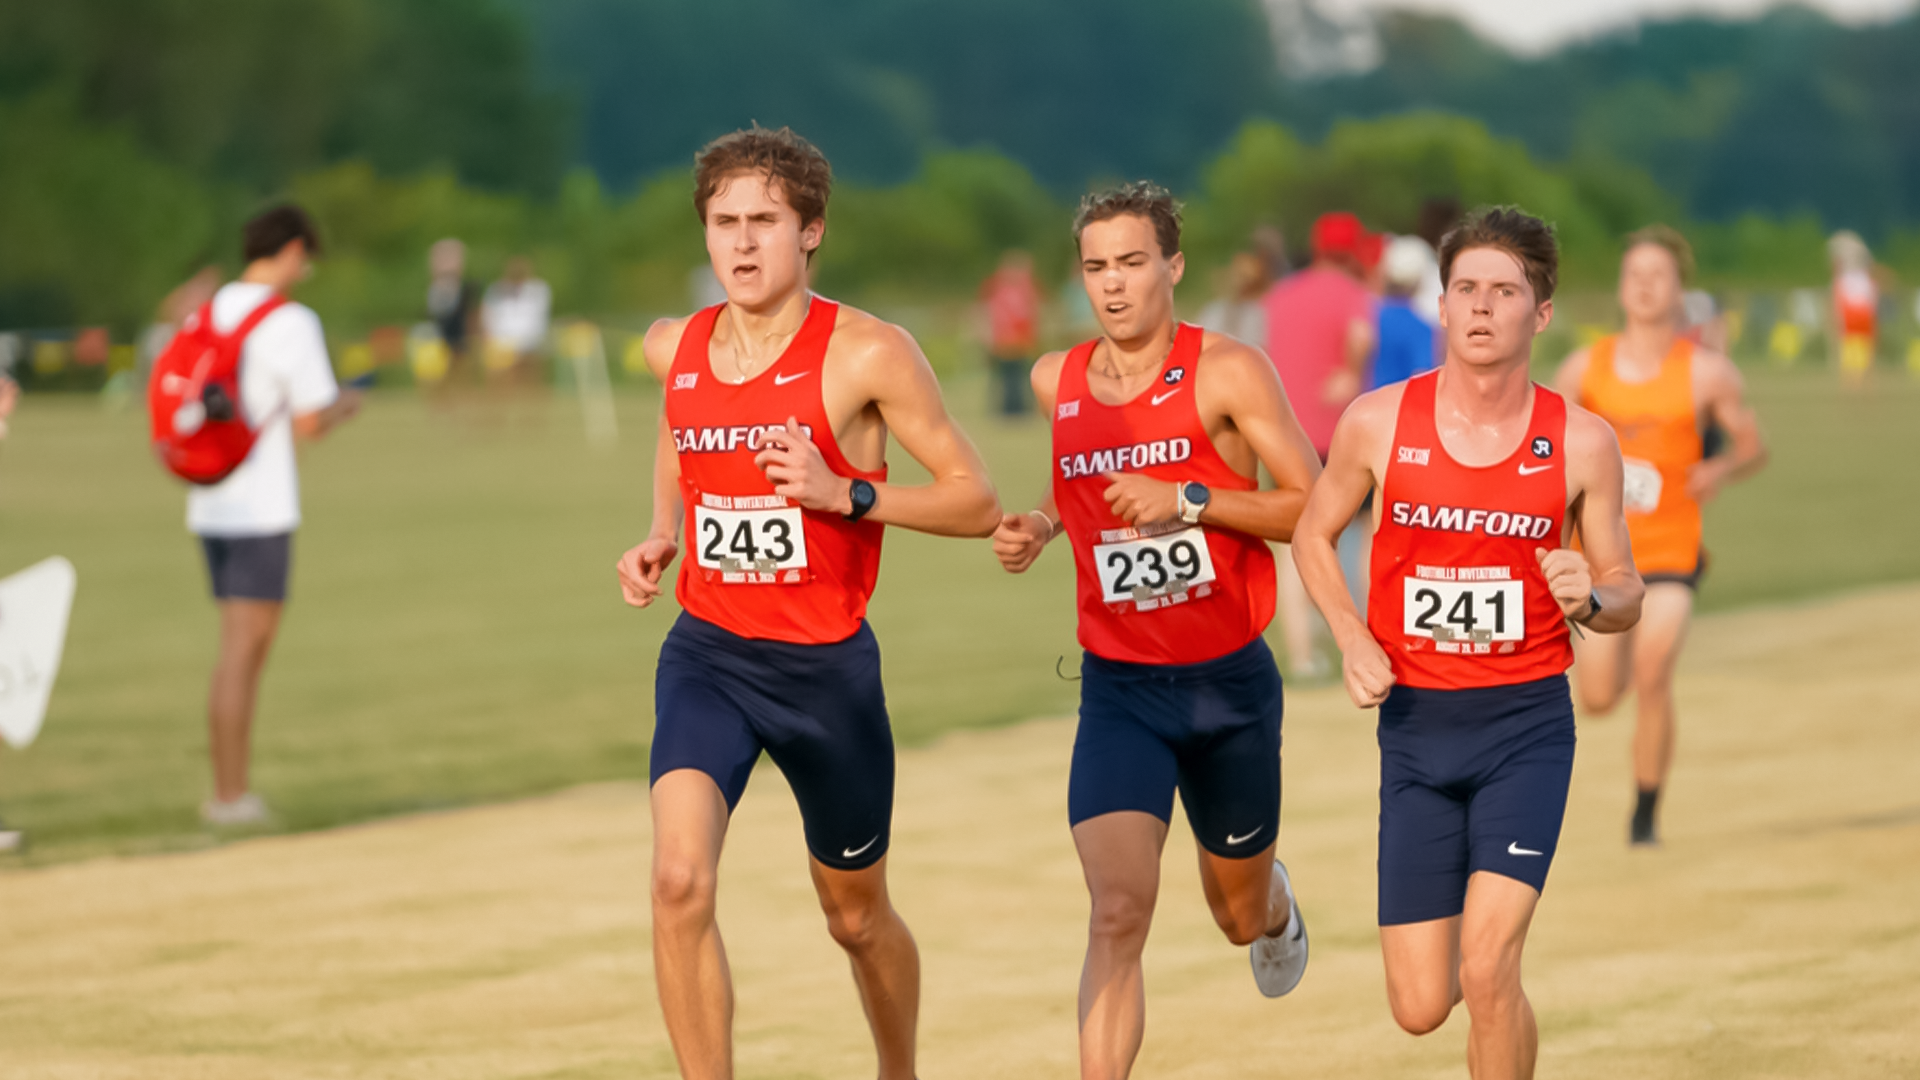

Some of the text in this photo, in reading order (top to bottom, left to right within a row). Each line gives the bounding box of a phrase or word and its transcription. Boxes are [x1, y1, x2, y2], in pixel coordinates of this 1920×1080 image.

[1059, 437, 1192, 480] SAMFORD
[703, 517, 794, 562] 243
[1392, 501, 1554, 539] SAMFORD
[1108, 540, 1200, 594] 239
[1415, 588, 1504, 633] 241
